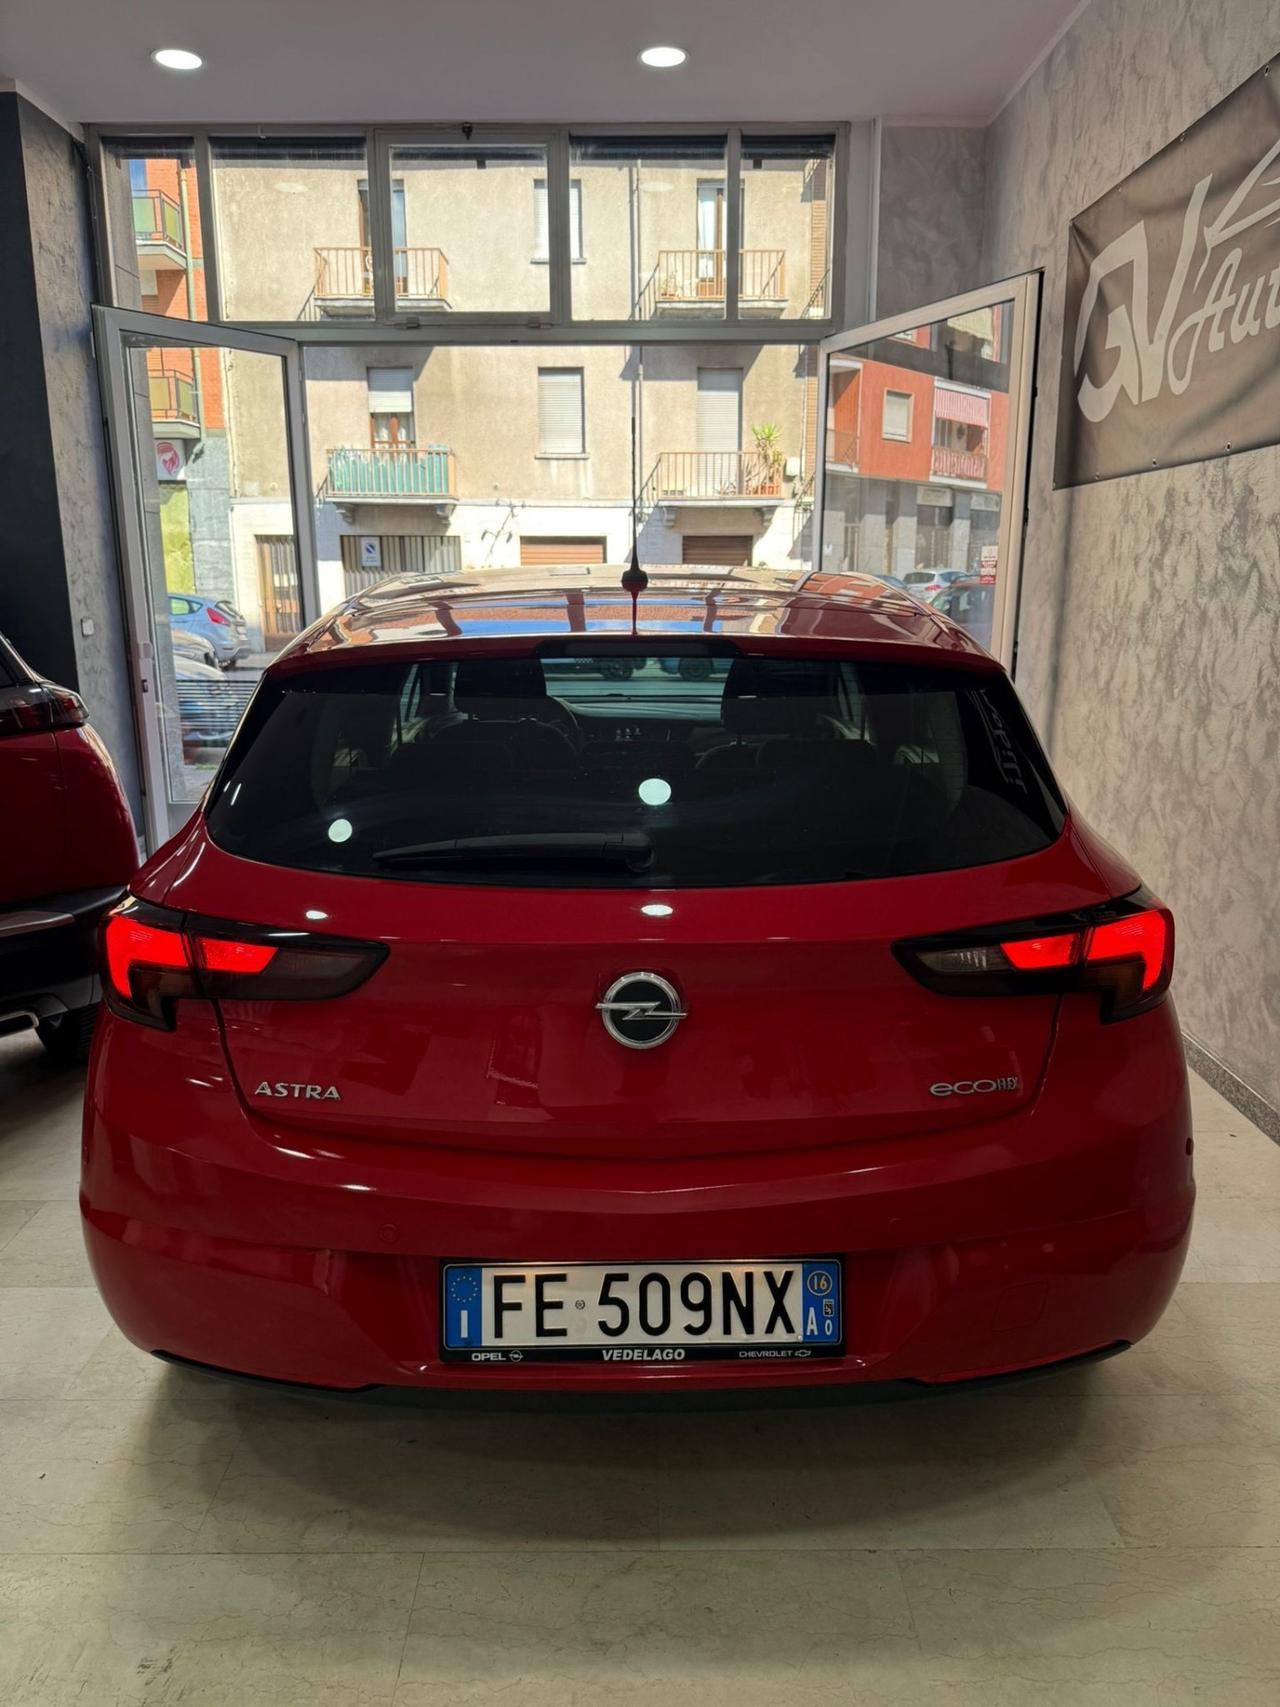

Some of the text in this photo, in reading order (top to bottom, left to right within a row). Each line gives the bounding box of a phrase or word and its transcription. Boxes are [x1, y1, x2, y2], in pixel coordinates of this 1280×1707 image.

[254, 1081, 341, 1101] ASTRA
[813, 1275, 828, 1291] 16
[493, 1270, 796, 1339] FE 509NX
[471, 1352, 507, 1362] OPEL
[602, 1348, 686, 1362] VEDELAGO
[739, 1350, 793, 1358] CHEVROLET
